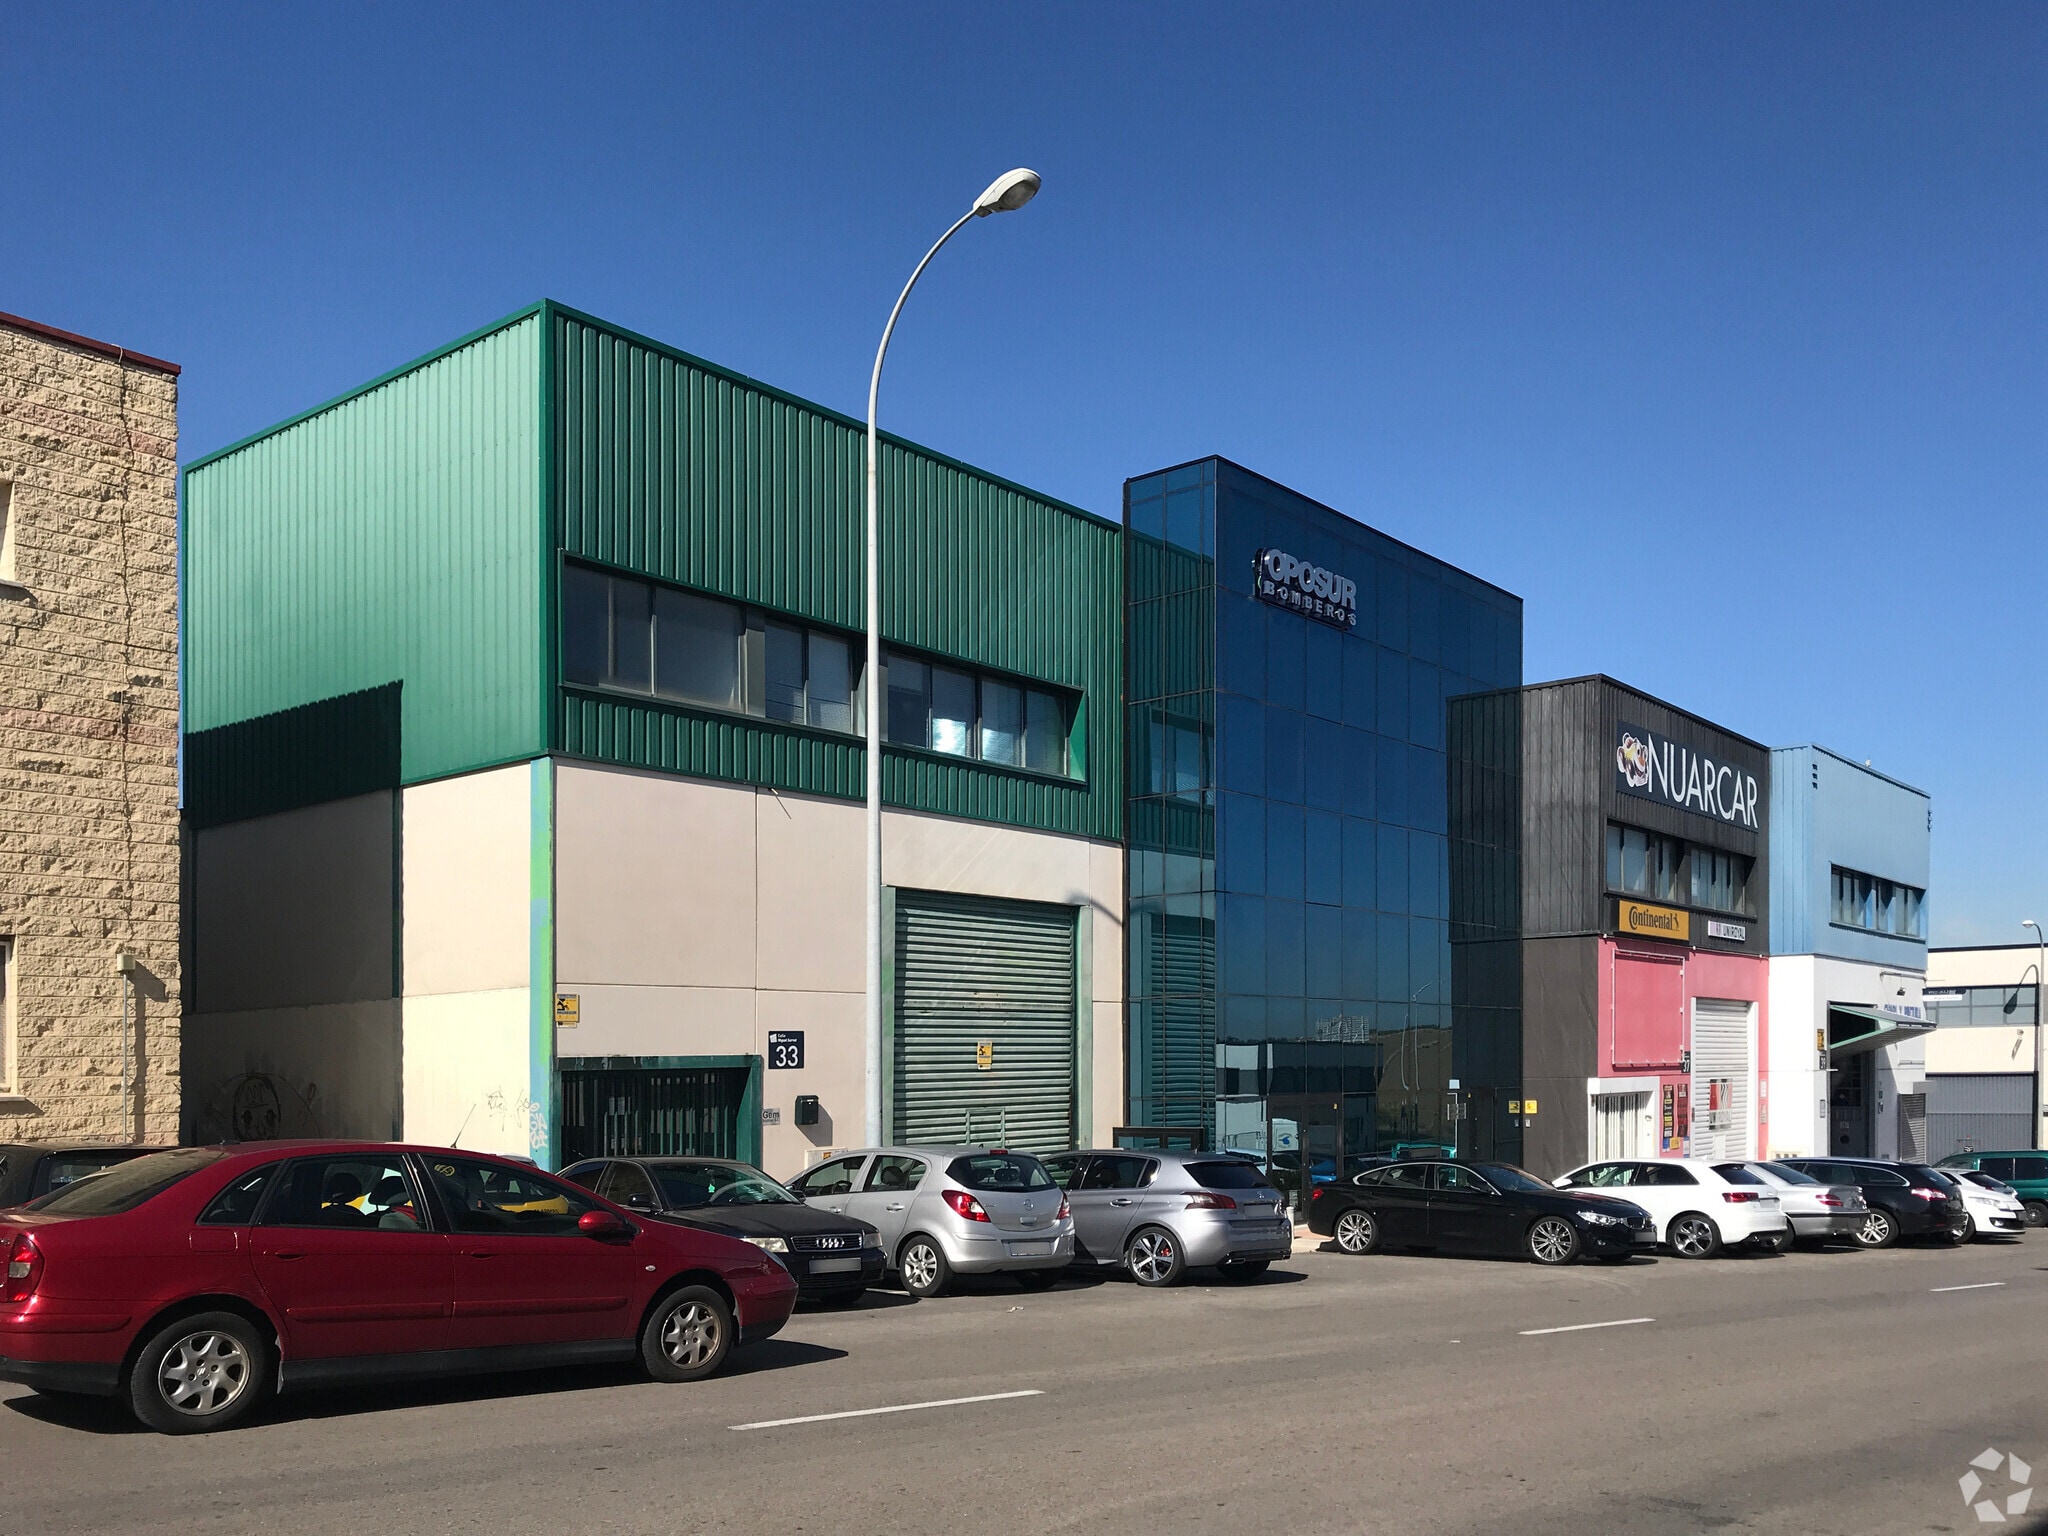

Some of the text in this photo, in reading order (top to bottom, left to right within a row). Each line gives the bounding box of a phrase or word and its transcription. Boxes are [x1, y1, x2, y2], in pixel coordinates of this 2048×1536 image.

[1265, 548, 1357, 611] OPOSUR
[1263, 580, 1357, 626] BOMBEROS
[1648, 733, 1758, 829] NUARCAR
[1629, 905, 1673, 931] Continental
[776, 1045, 799, 1067] 33
